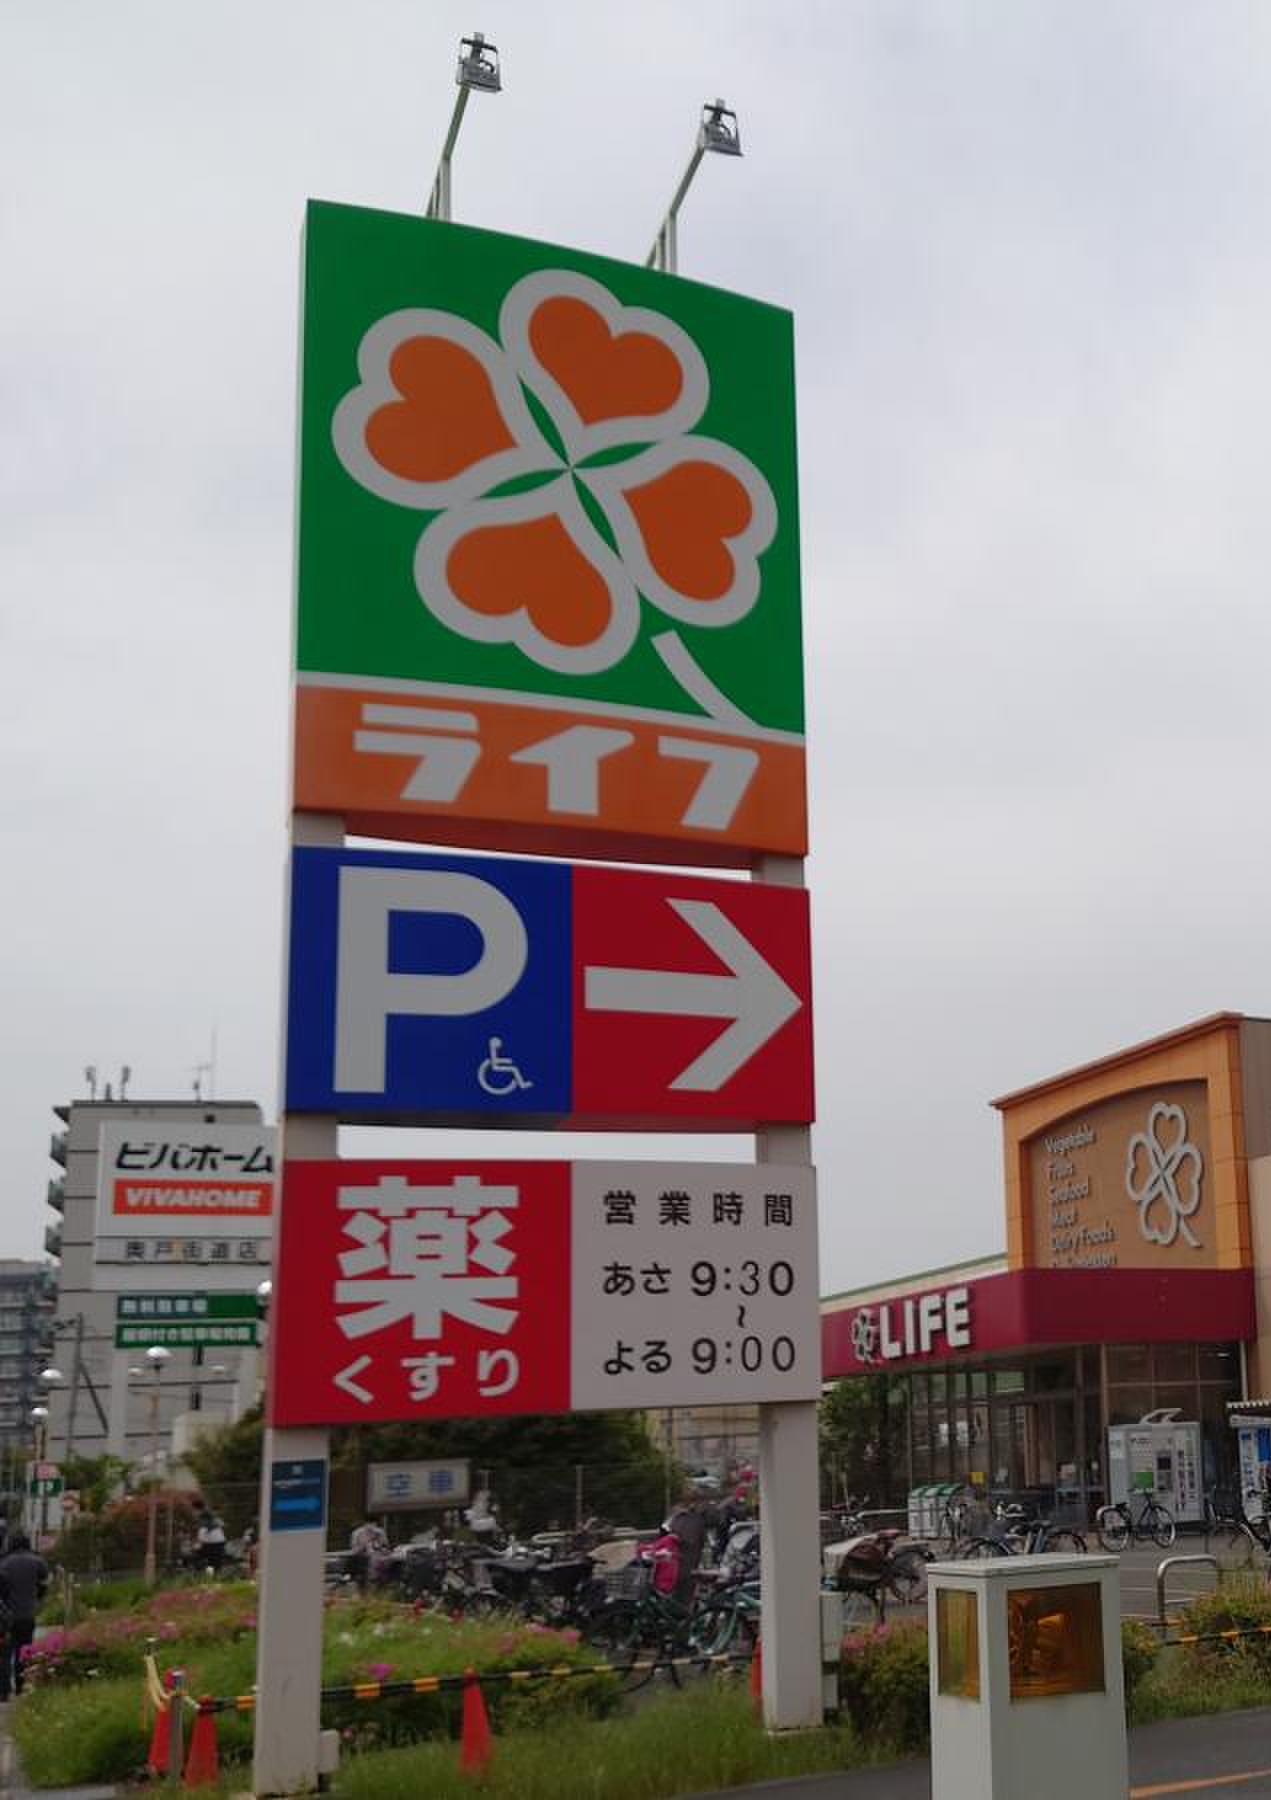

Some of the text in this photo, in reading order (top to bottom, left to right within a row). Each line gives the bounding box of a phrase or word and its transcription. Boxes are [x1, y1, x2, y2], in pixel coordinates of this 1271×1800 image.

[353, 702, 759, 831] ライフ
[332, 865, 528, 1093] P
[115, 1142, 273, 1172] ビバホーム
[125, 1187, 262, 1208] VIVAHOME
[603, 1189, 795, 1227] 営業時間
[335, 1175, 519, 1340] 薬
[602, 1261, 795, 1298] あさ 9:30
[879, 1288, 972, 1359] LIFE
[333, 1350, 519, 1404] くすり
[603, 1336, 796, 1375] よる 9:00
